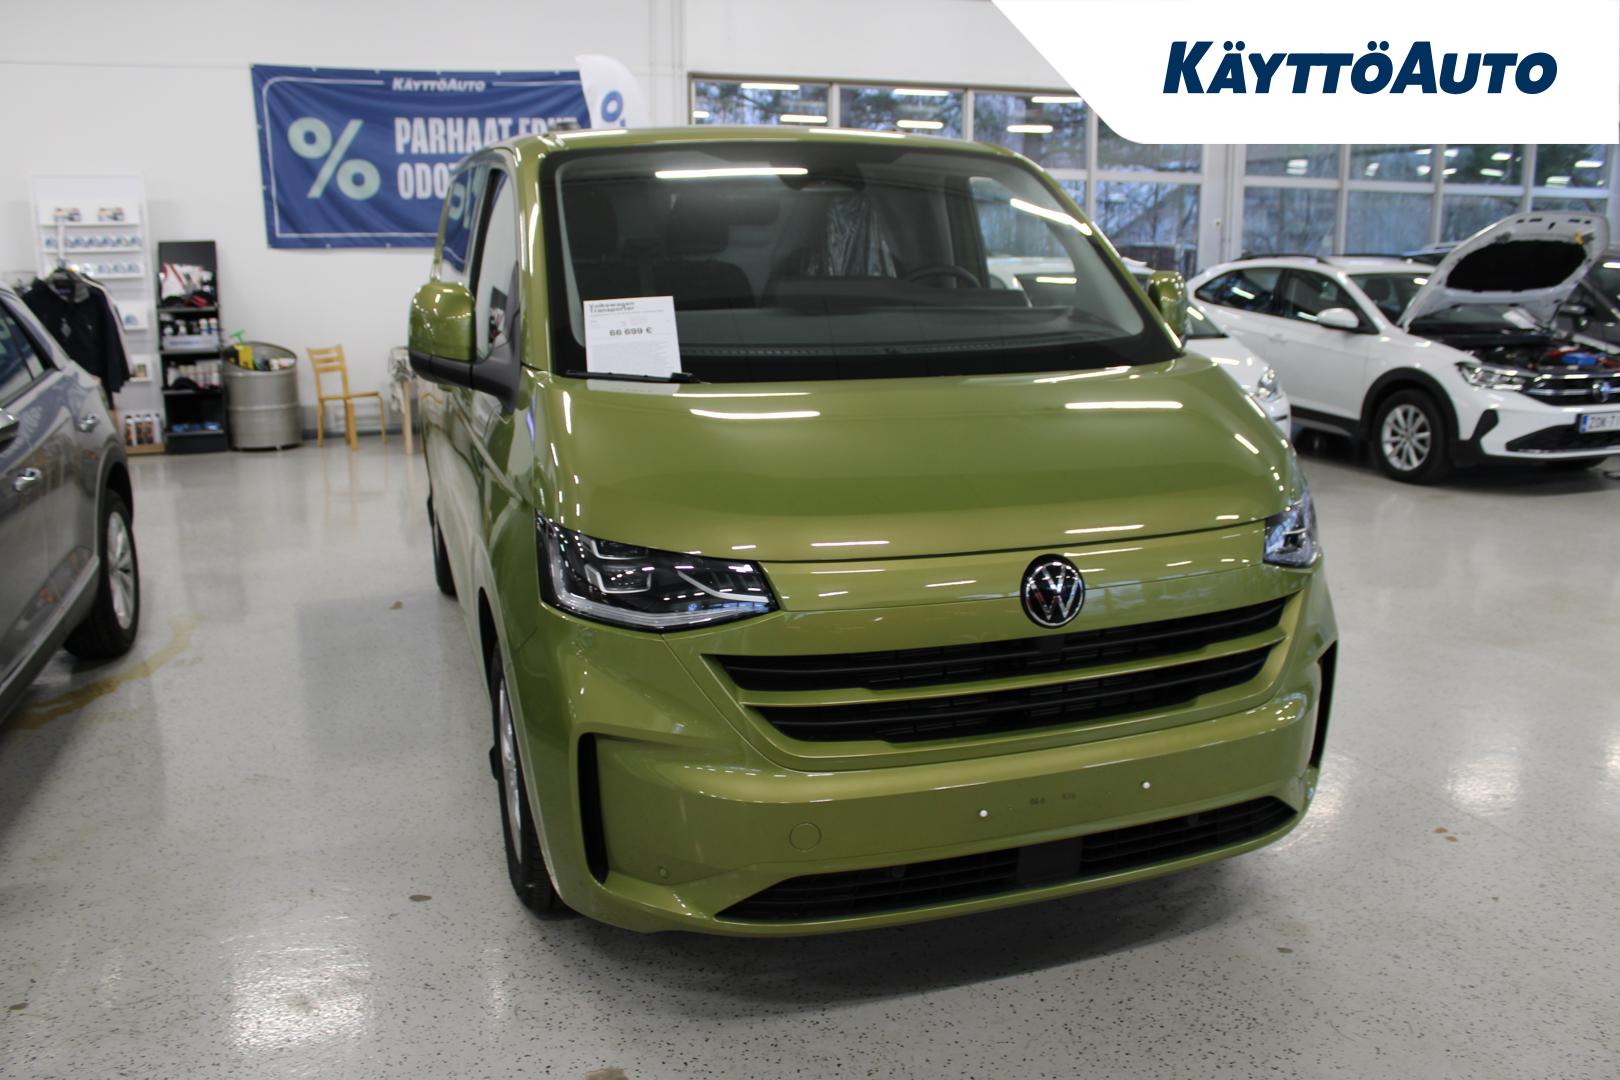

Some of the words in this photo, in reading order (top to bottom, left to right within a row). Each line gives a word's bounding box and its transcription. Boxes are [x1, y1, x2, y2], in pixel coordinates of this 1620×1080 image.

[394, 117, 513, 154] PARHAAT
[397, 162, 456, 199] ODO
[609, 328, 622, 336] 66
[624, 327, 643, 335] 699
